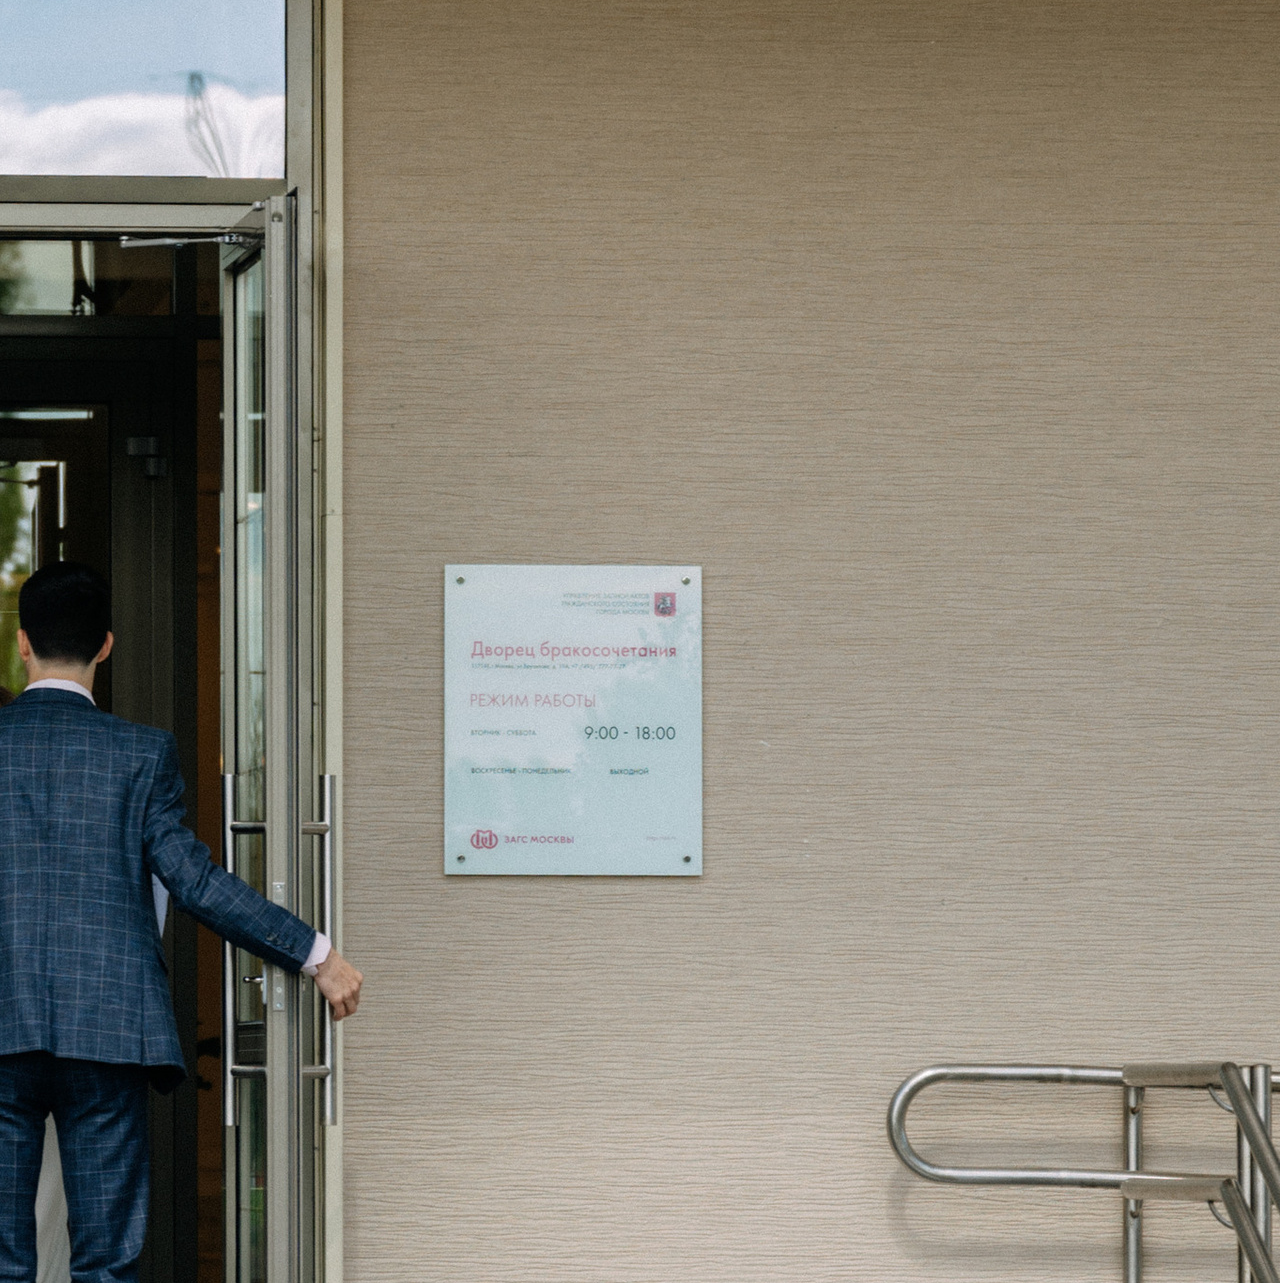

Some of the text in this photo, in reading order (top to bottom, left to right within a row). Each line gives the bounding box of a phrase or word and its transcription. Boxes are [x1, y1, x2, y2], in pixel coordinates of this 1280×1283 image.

[471, 641, 677, 661] Дворец бракосочетания
[470, 693, 596, 708] РЕЖИМ РАБОТЫ
[584, 726, 619, 740] 9:00
[635, 726, 676, 740] 18:00
[609, 767, 649, 776] ВЫХОДНОЙ
[504, 835, 575, 844] ЗАГС МОСКВЫ
